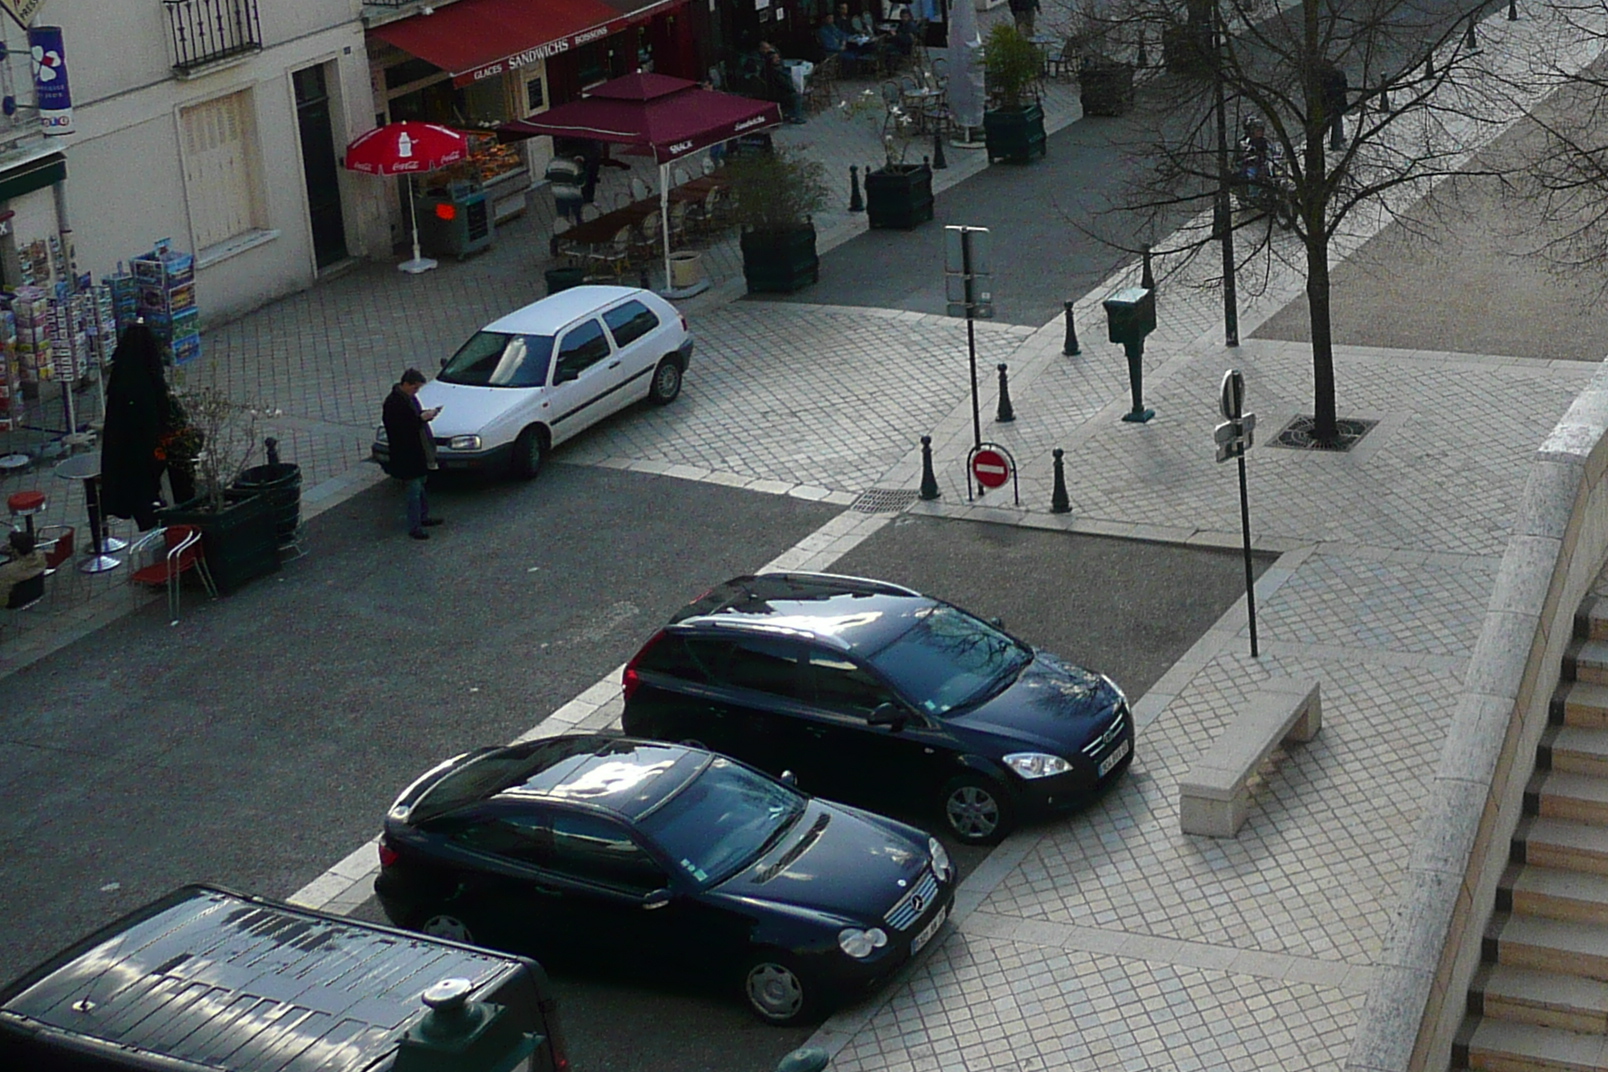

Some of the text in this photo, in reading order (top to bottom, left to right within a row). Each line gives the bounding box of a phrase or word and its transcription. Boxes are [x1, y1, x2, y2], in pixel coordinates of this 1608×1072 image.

[474, 26, 608, 80] GLACES SANDWICHS BOISSONS
[669, 140, 694, 155] SNACK
[392, 160, 419, 171] Coca-Cola
